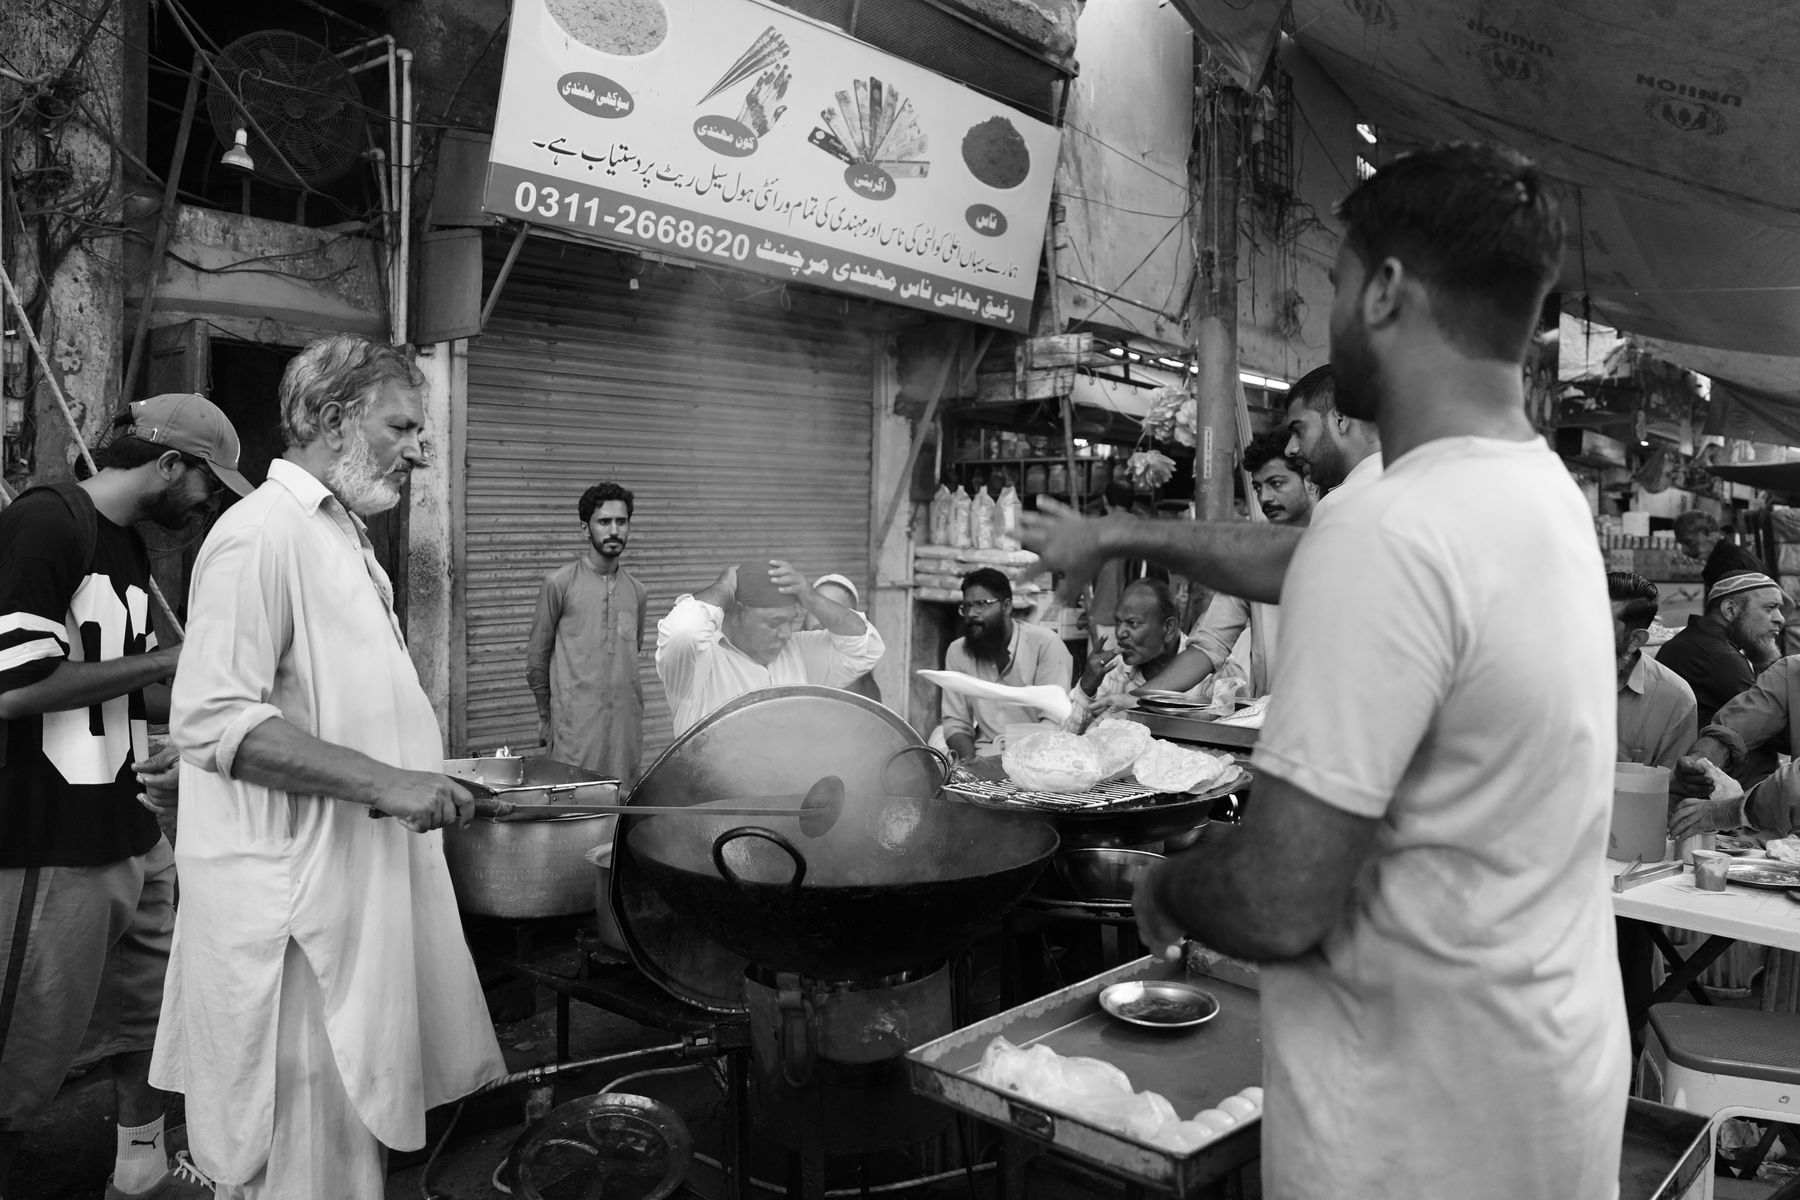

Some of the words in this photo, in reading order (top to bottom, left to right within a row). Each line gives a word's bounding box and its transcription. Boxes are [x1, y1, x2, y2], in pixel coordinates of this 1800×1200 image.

[562, 81, 595, 100] مہندی
[596, 91, 630, 111] سوکھی
[697, 125, 734, 143] مہندی
[735, 136, 754, 150] کون
[514, 181, 750, 261] 0311-2668620
[788, 196, 818, 228] تمام
[815, 196, 838, 228] کی
[829, 207, 867, 238] مہندی
[862, 221, 881, 238] اور
[832, 262, 897, 291] مہندی
[900, 278, 932, 299] ناس
[981, 293, 1015, 323] رفیق
